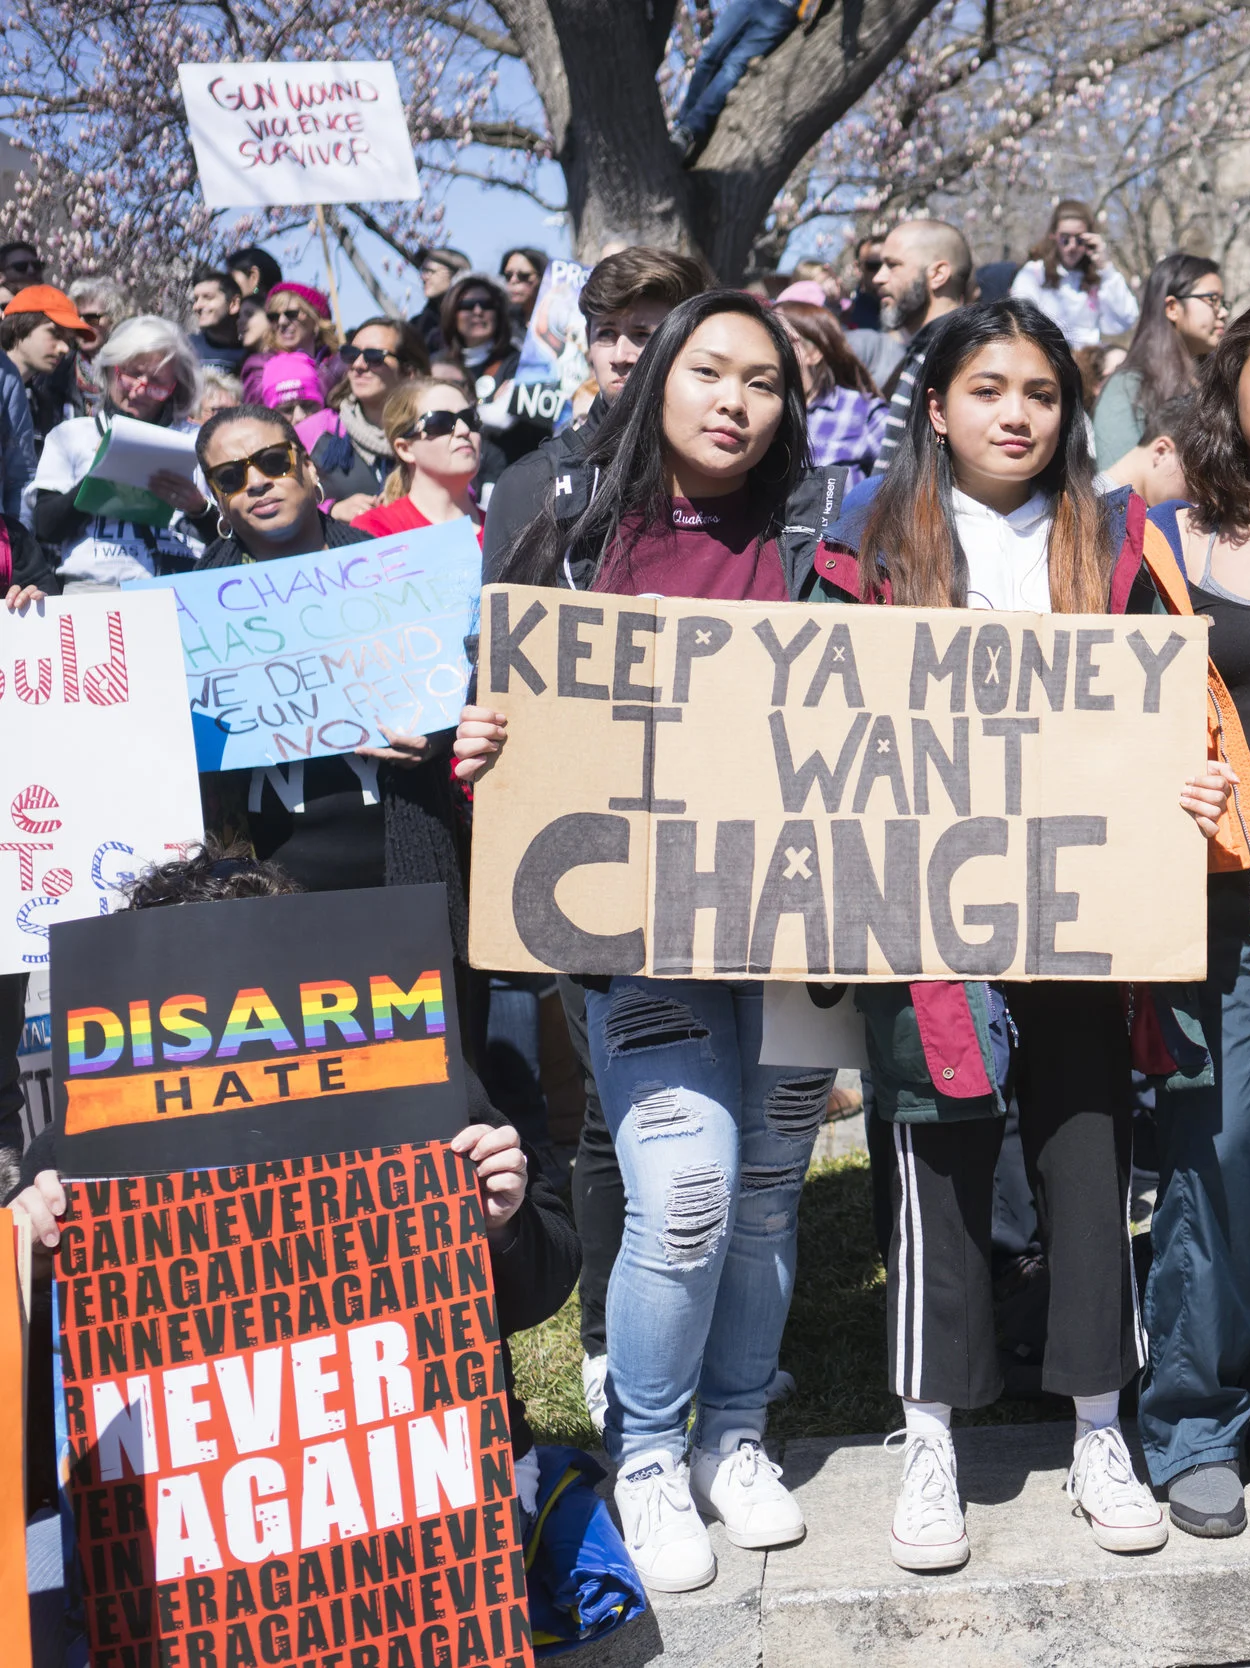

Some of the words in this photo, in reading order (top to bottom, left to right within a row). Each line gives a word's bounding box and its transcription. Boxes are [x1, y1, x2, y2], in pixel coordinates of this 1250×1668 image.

[208, 76, 279, 110] GUN
[672, 508, 721, 526] Quakers
[217, 544, 425, 611] CHANGE
[0, 611, 129, 706] uld
[181, 615, 286, 668] HAS
[264, 626, 443, 698] DEMAND
[489, 592, 733, 703] KEEP
[752, 618, 866, 709] YA
[909, 621, 1188, 716] MONEY
[214, 693, 319, 735] GUN
[608, 704, 687, 813] I
[768, 709, 1040, 816] WANT
[511, 811, 1114, 976] CHANGE
[66, 969, 447, 1076] DISARM
[154, 1056, 345, 1113] HATE
[92, 1320, 415, 1481] NEVER
[155, 1406, 478, 1582] AGAIN
